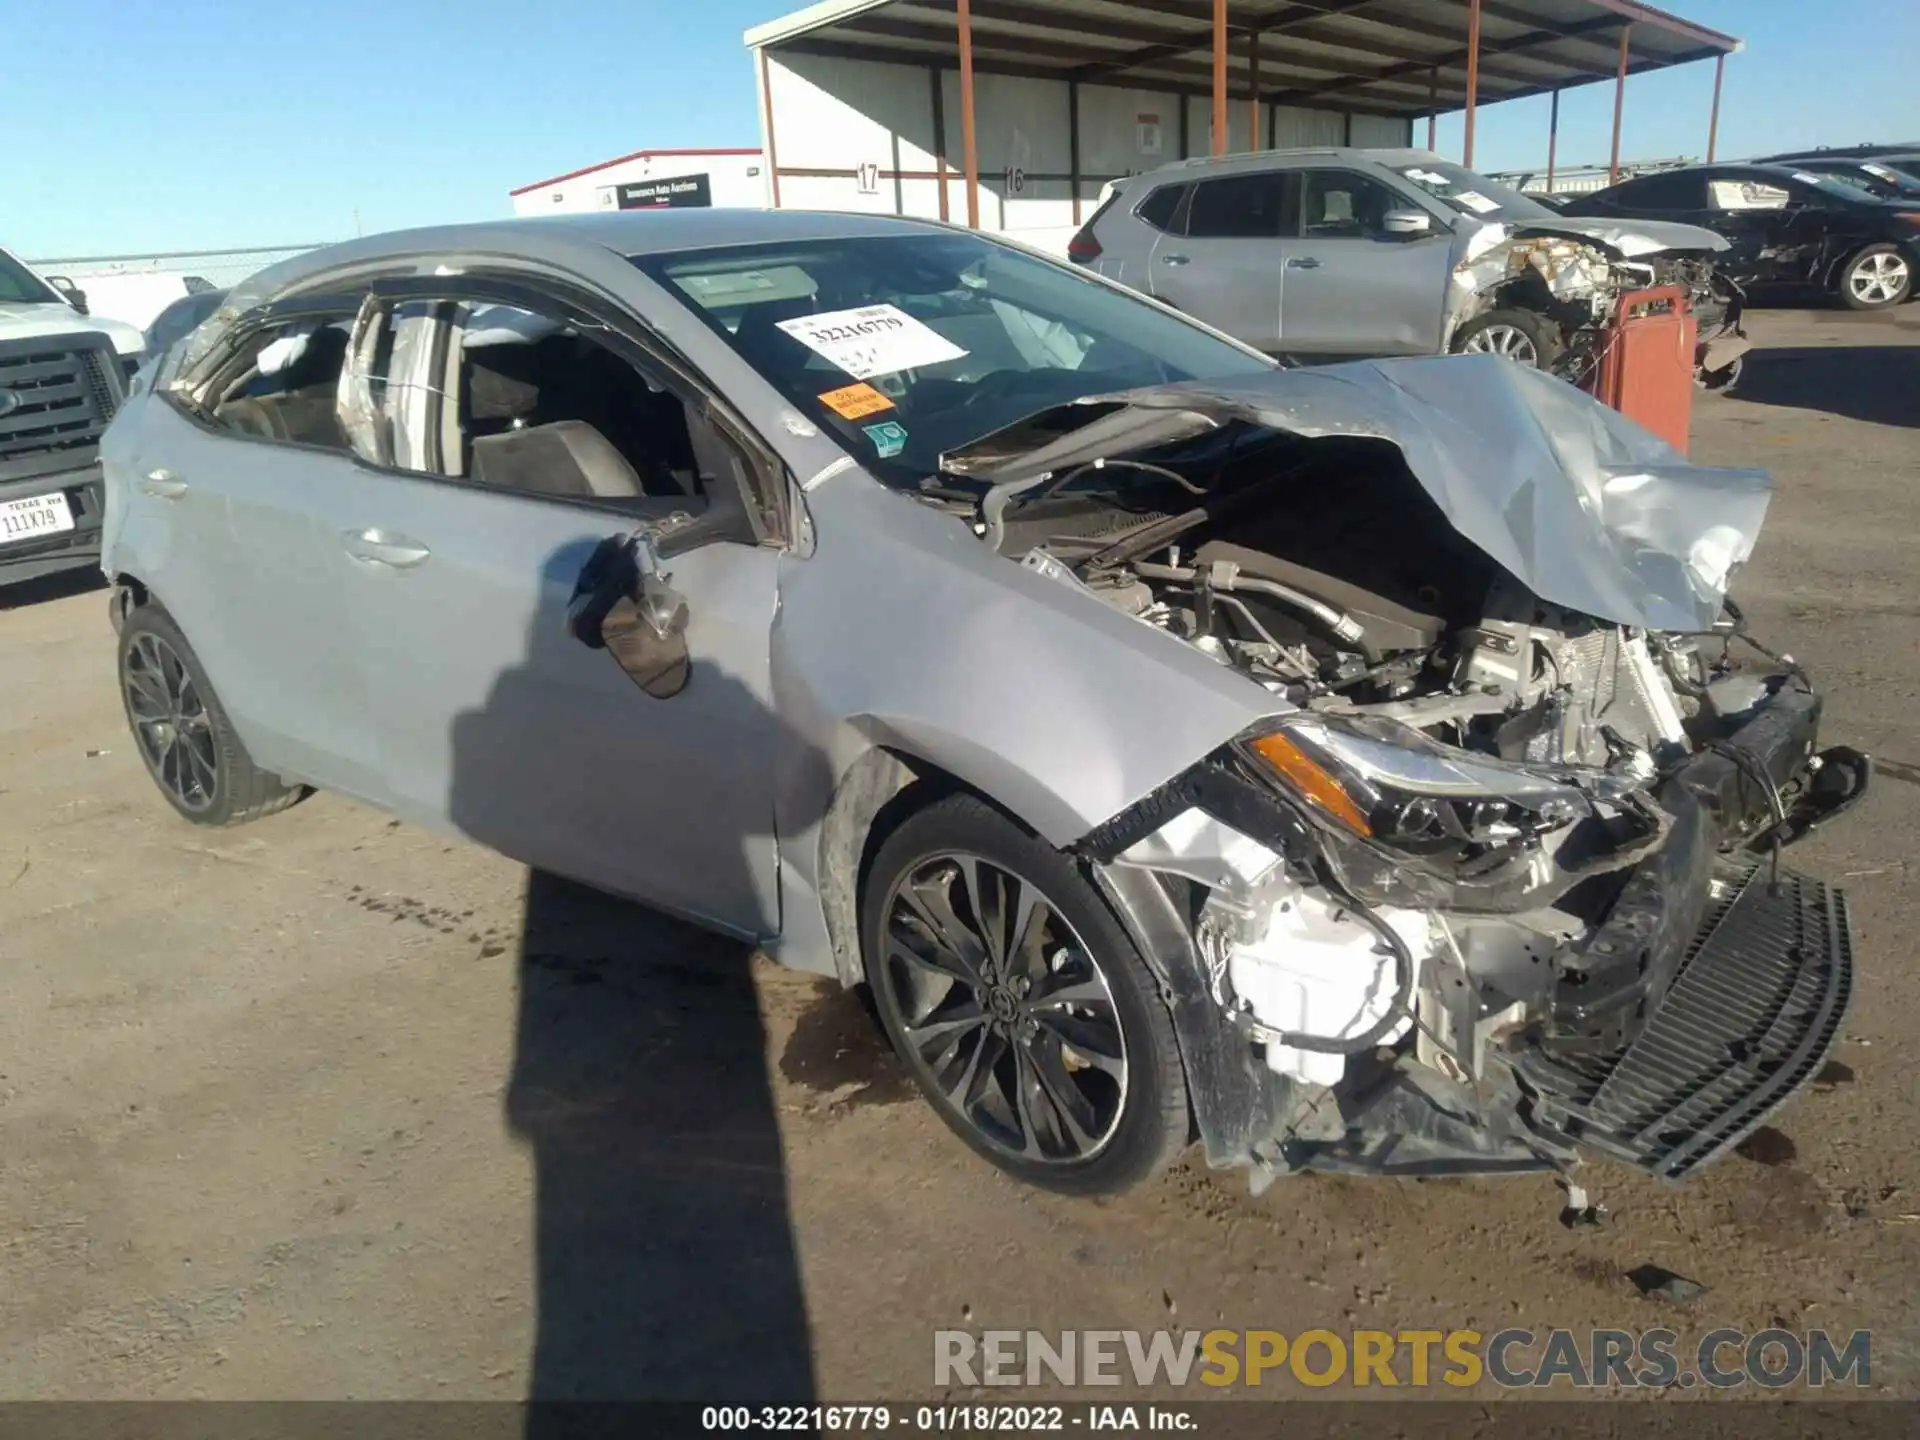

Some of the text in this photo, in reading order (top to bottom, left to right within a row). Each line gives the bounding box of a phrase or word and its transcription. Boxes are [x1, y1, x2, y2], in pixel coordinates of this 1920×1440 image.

[858, 163, 878, 190] 17
[1006, 168, 1024, 192] 16
[809, 317, 903, 342] 32216779
